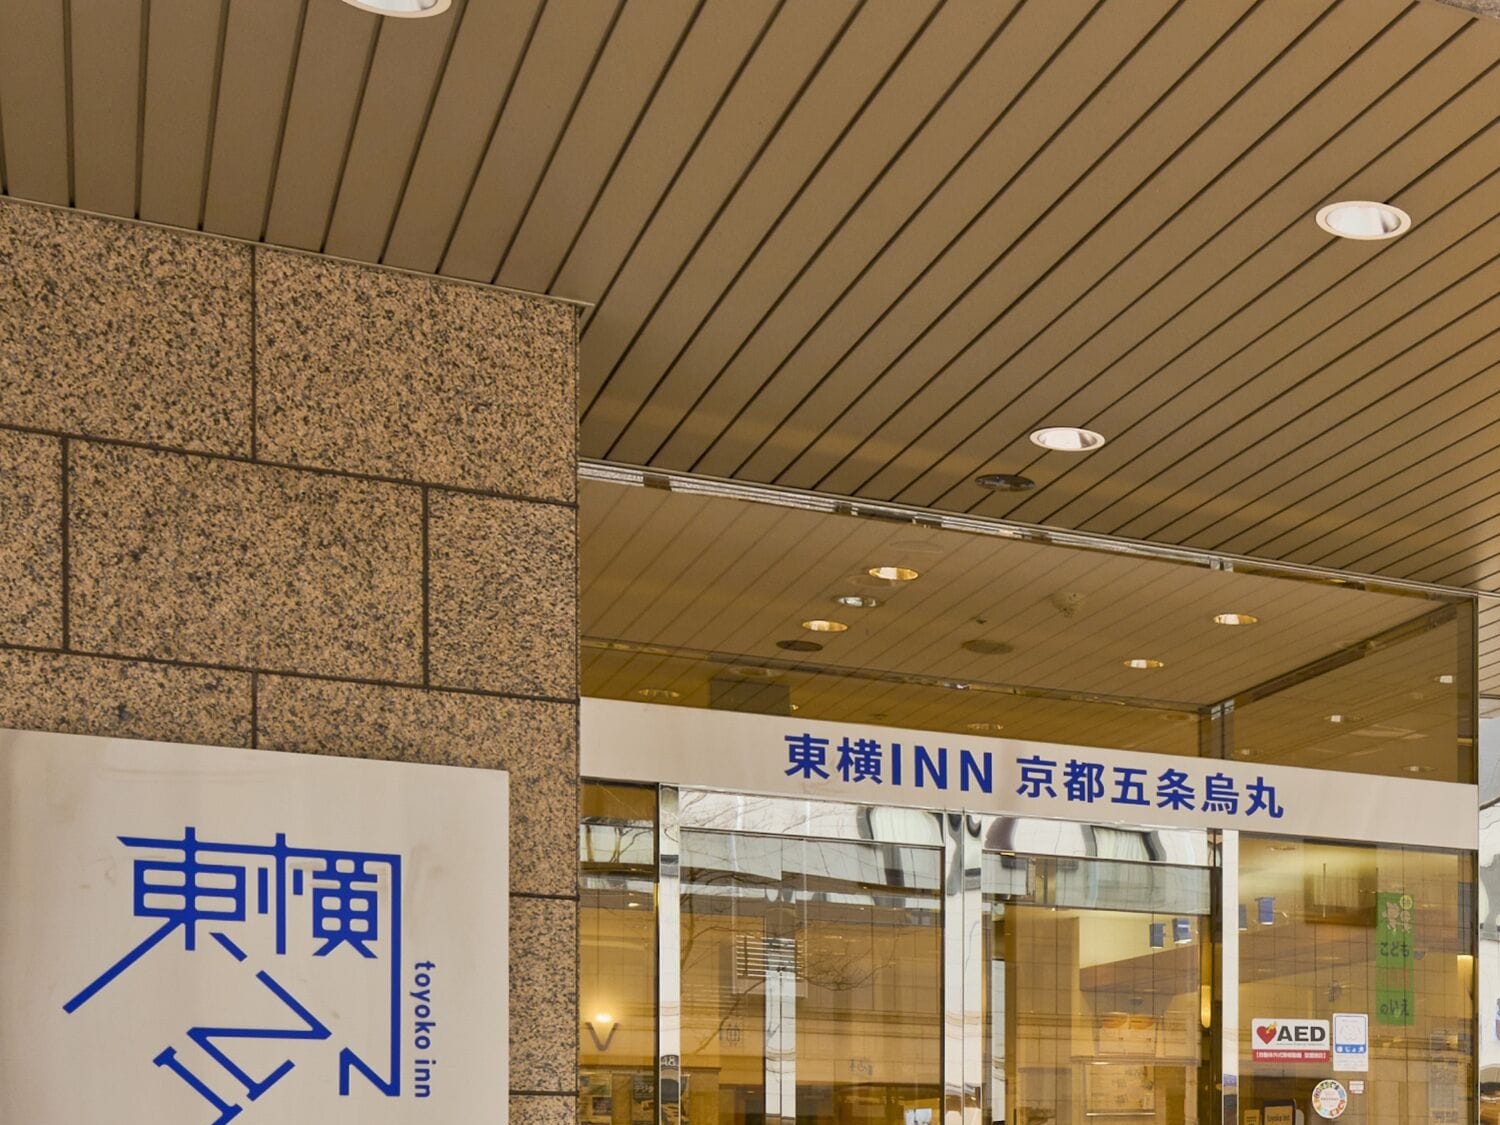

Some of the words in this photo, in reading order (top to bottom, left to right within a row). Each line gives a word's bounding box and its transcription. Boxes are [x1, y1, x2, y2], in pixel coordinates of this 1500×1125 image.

[786, 734, 994, 795] 東横INN
[1018, 755, 1285, 816] 京都五条烏丸
[409, 959, 437, 1051] toyoko
[1276, 1026, 1326, 1042] AED
[413, 1057, 437, 1099] inn
